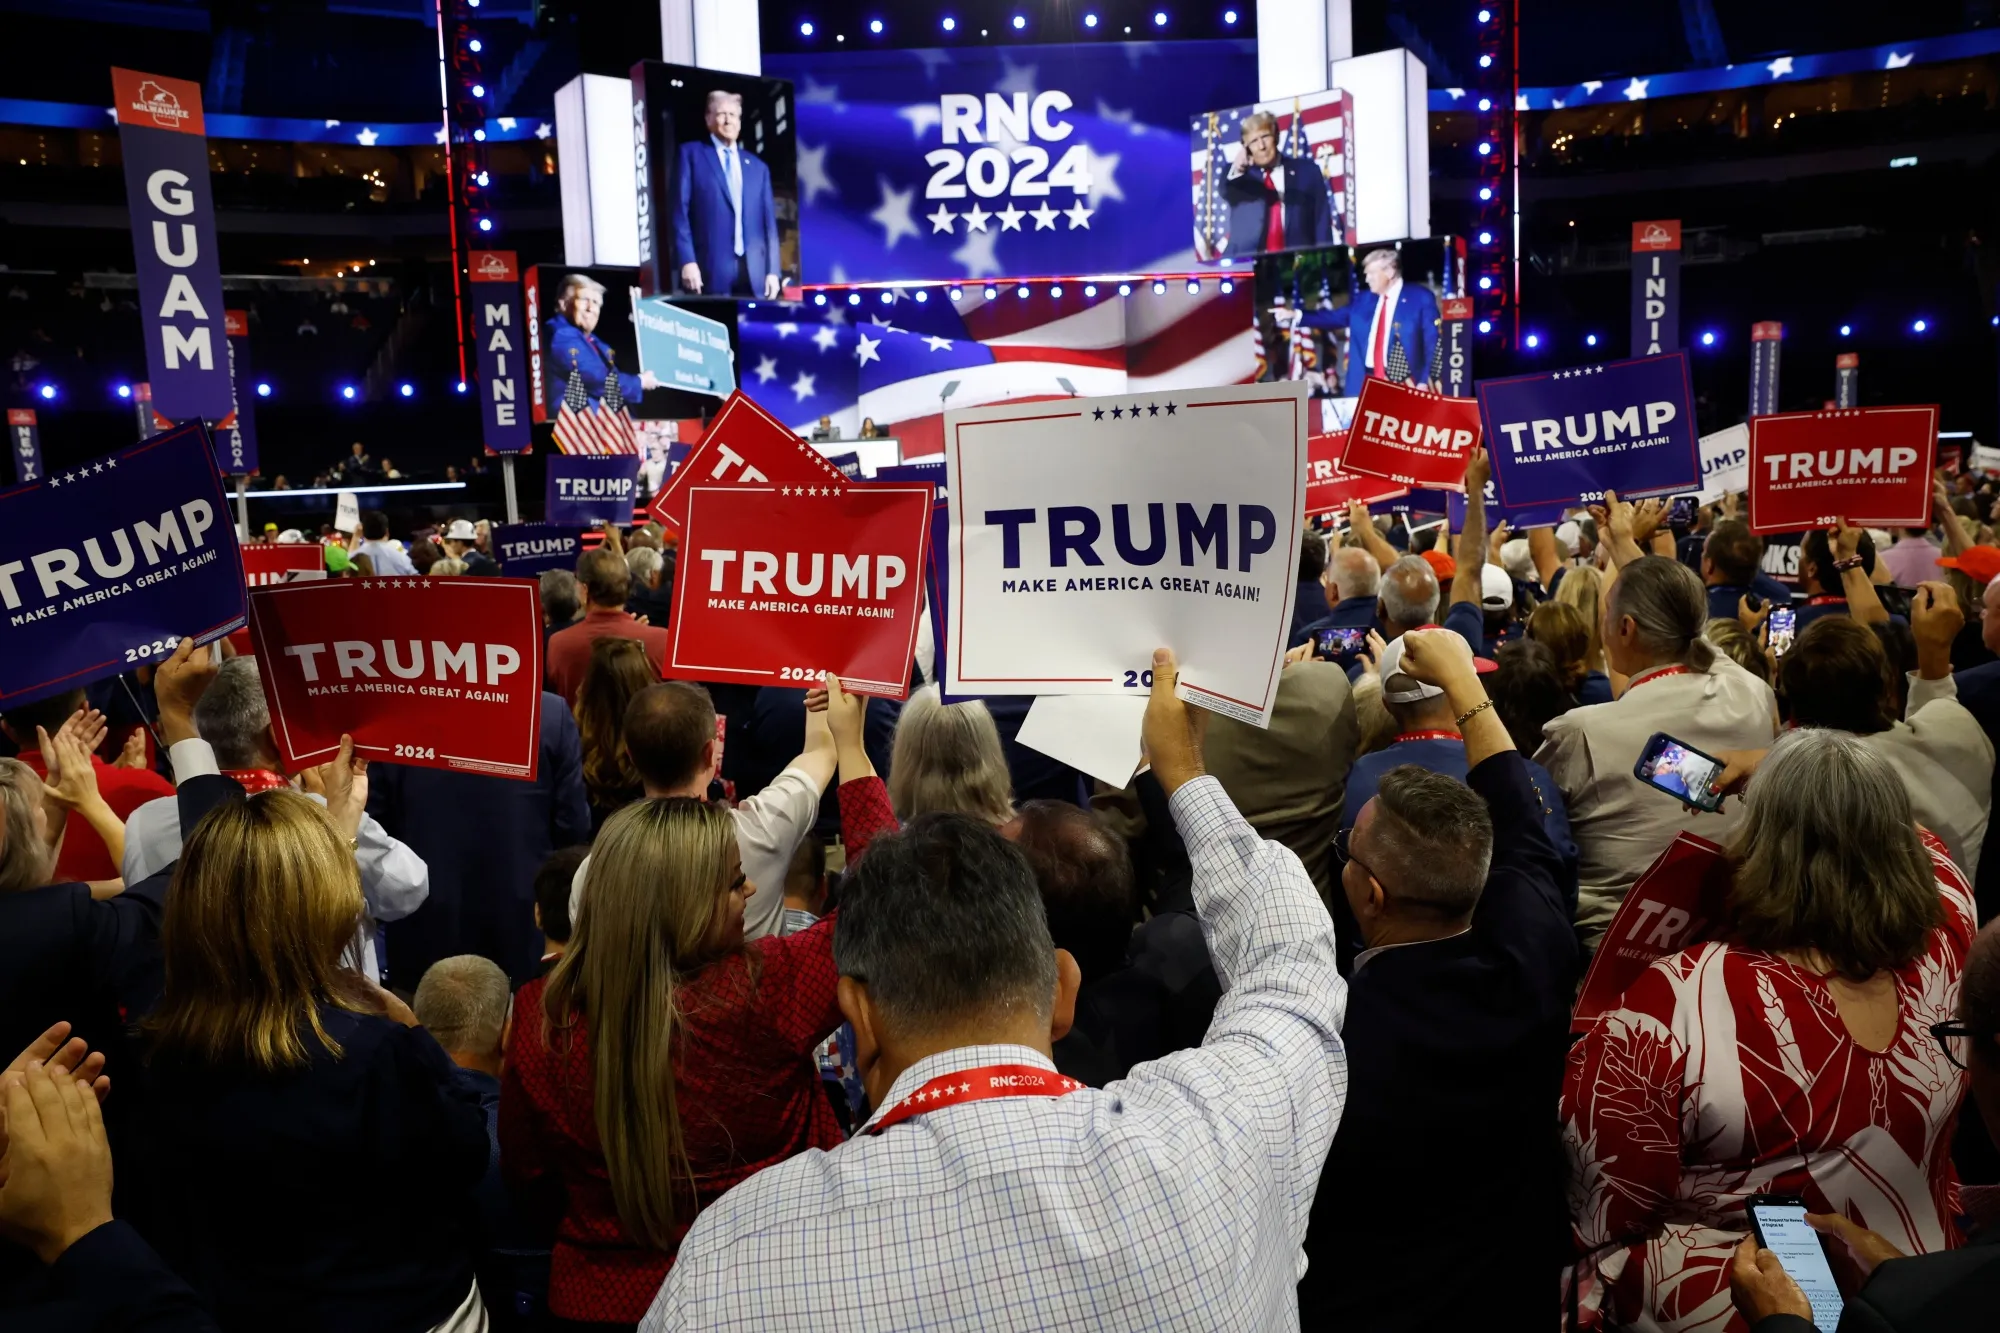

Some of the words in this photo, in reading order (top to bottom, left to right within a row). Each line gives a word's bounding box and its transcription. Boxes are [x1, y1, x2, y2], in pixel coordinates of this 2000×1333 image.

[131, 101, 189, 119] MILWAUKEE
[940, 90, 1074, 144] RNC
[633, 99, 648, 191] 2024
[1344, 110, 1354, 176] 2024
[924, 145, 1095, 199] 2024
[1345, 177, 1355, 228] RNC
[636, 192, 651, 263] RNC
[147, 168, 214, 371] GUAM
[527, 285, 540, 351] 2024
[1646, 256, 1666, 356] INDIA
[484, 303, 517, 426] MAINE
[532, 354, 543, 406] RNC
[1449, 322, 1465, 398] FLORI
[17, 426, 35, 458] NEW
[1363, 434, 1380, 445] MAKE
[1381, 439, 1411, 452] AMERICA
[1412, 447, 1436, 457] GREAT
[1437, 449, 1464, 459] AGAIN!
[1364, 410, 1473, 451] TRUMP
[1501, 401, 1677, 454] TRUMP
[1515, 455, 1543, 465] MAKE
[1545, 448, 1590, 462] AMERICA
[1593, 443, 1628, 456] GREAT
[1631, 435, 1671, 451] AGAIN!
[1763, 447, 1918, 482] TRUMP
[555, 477, 633, 496] TRUMP
[1391, 473, 1415, 485] 2024
[1769, 482, 1794, 492] MAKE
[1795, 477, 1834, 489] AMERICA
[1836, 476, 1868, 486] GREAT
[1870, 476, 1908, 486] AGAIN!
[984, 502, 1277, 574] TRUMP
[1816, 515, 1838, 526] 202
[0, 498, 214, 611] TRUMP
[501, 537, 576, 557] TRUMP
[10, 604, 58, 627] MAKE
[62, 581, 133, 613] AMERICA
[136, 565, 178, 589] GREAT
[182, 548, 218, 573] AGAIN!
[701, 549, 907, 600] TRUMP
[1002, 579, 1058, 594] MAKE
[1064, 576, 1154, 593] AMERICA
[1160, 577, 1211, 595] GREAT
[1214, 581, 1261, 603] AGAIN!
[707, 598, 745, 611] MAKE
[749, 601, 810, 615] AMERICA
[814, 604, 853, 617] GREAT
[856, 606, 895, 620] AGAIN!
[124, 636, 179, 664] 2024
[284, 639, 521, 687] TRUMP
[308, 684, 350, 698] MAKE
[354, 683, 416, 695] AMERICA
[420, 686, 461, 699] GREAT
[465, 690, 510, 705] AGAIN!
[779, 666, 827, 683] 2024
[393, 743, 436, 761] 2024
[1616, 947, 1641, 960] MAKE
[989, 1075, 1046, 1088] RNC2024
